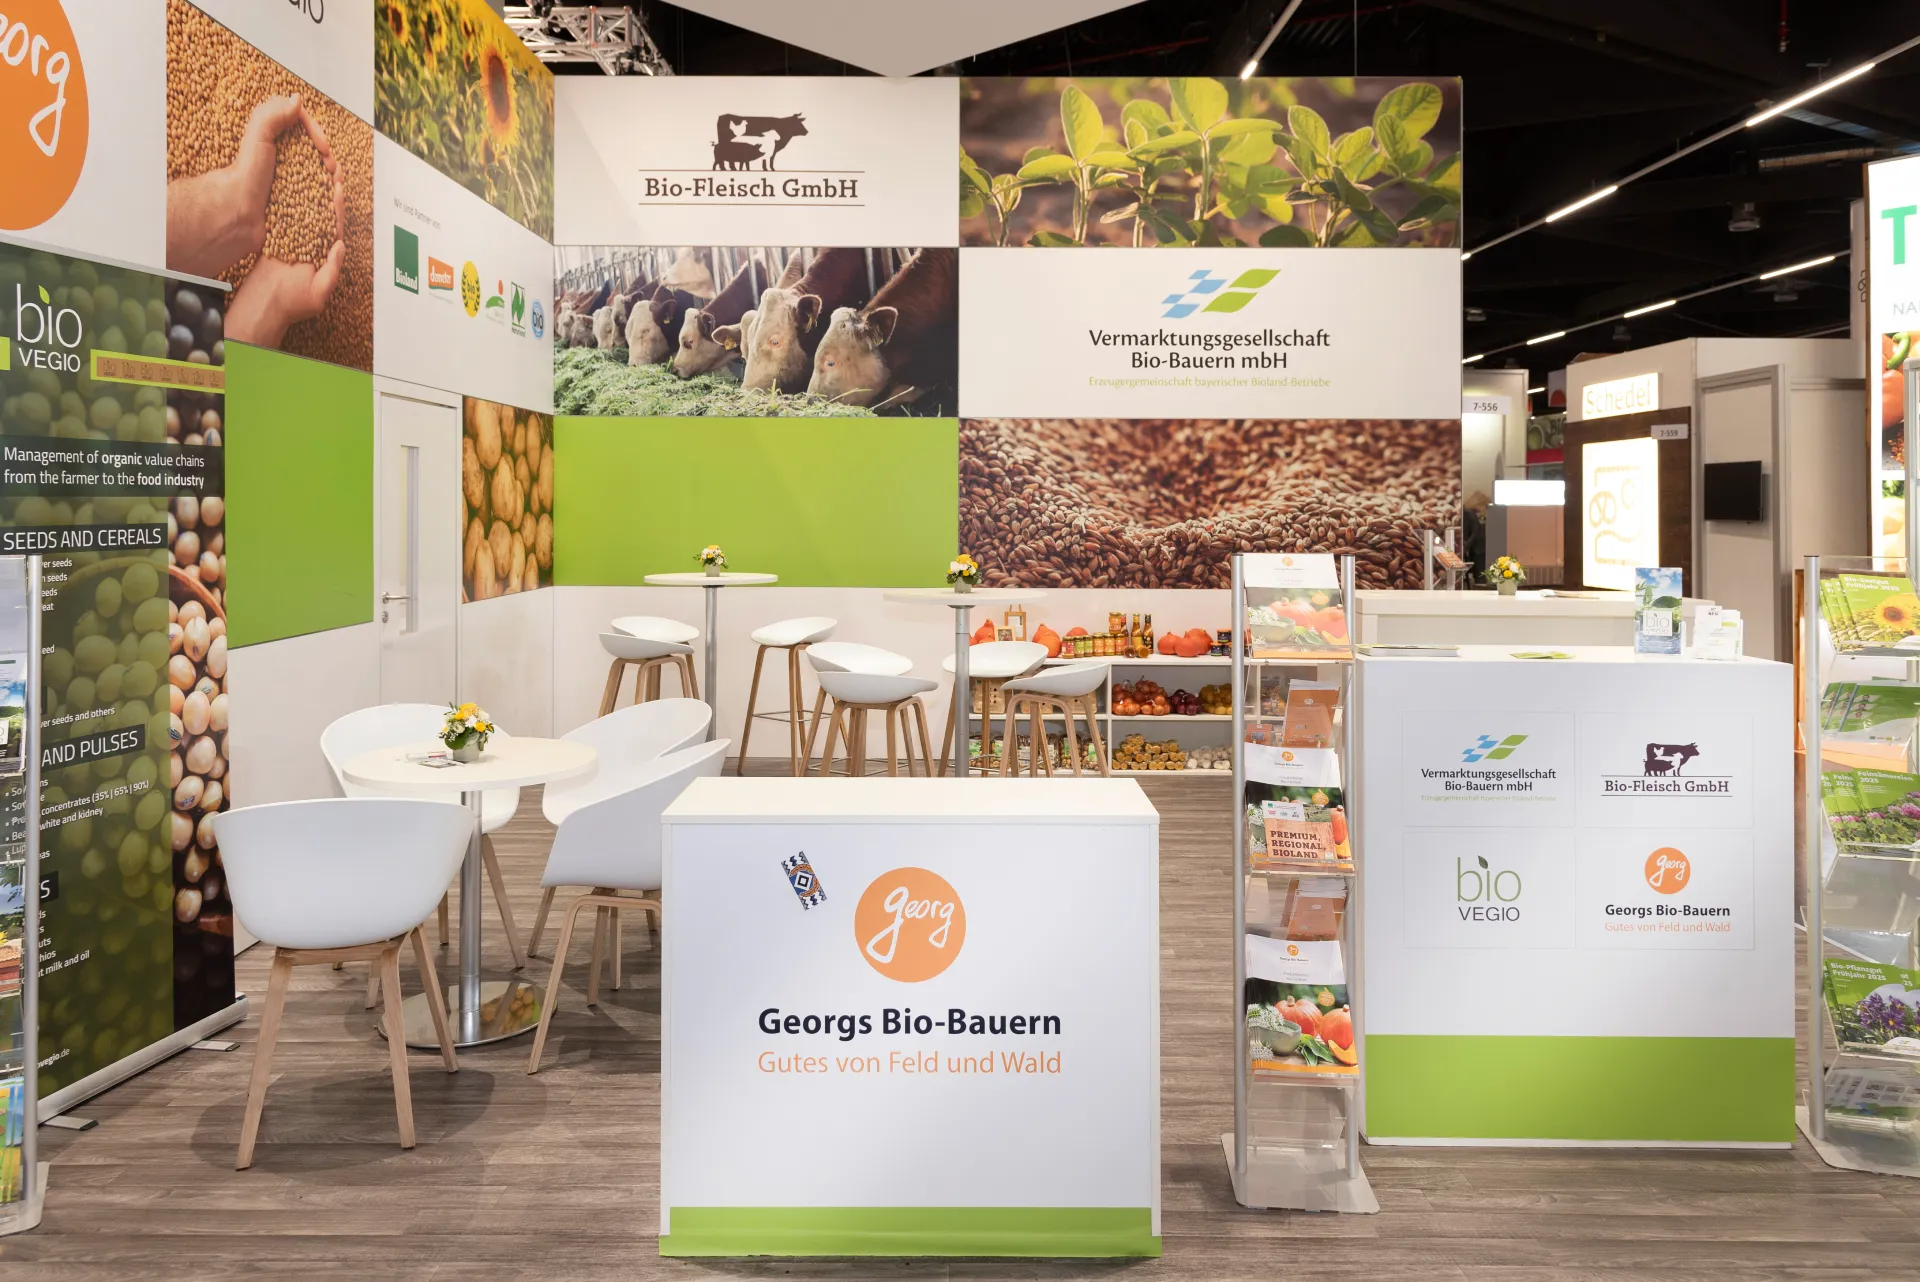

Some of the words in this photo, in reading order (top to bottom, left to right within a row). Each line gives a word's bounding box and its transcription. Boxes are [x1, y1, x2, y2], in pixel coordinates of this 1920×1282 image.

[645, 178, 776, 198] Bio-Fleisch
[782, 178, 859, 198] GmbH
[1881, 205, 1920, 265] T
[395, 267, 418, 290] Bioland
[17, 283, 82, 348] bio
[1089, 329, 1331, 351] Vermarktungsgesellschaft
[18, 348, 81, 373] VEGIO
[1132, 351, 1235, 369] Bio-Bauern
[1241, 351, 1287, 369] mbH
[1089, 377, 1192, 387] Erzeugergemeinschaft
[1195, 377, 1248, 387] bayerischer
[1251, 377, 1331, 387] Bioland-Betriebe
[1473, 402, 1498, 412] 7-556
[1660, 429, 1679, 437] 7-559
[4, 446, 84, 465] Management
[87, 450, 99, 464] of
[102, 453, 142, 467] organic
[145, 455, 173, 467] value
[175, 454, 205, 467] chains
[4, 469, 36, 484] from
[40, 470, 59, 484] the
[62, 471, 99, 485] farmer
[102, 473, 115, 485] to
[117, 472, 135, 486] the
[137, 473, 161, 486] food
[164, 474, 204, 489] industry
[3, 531, 57, 550] SEEDS
[61, 530, 93, 548] AND
[97, 528, 162, 546] CEREALS
[52, 558, 73, 568] seeds
[47, 573, 68, 582] seeds
[41, 588, 58, 597] eeds
[51, 714, 73, 726] seeds
[75, 711, 89, 722] and
[91, 707, 115, 718] others
[41, 743, 76, 767] AND
[80, 730, 138, 758] PULSES
[1421, 768, 1557, 781] Vermarktungsgesellschaft
[1445, 780, 1504, 791] Bio-Bauern
[1506, 780, 1533, 791] mbH
[1604, 780, 1682, 793] Bio-Fleisch
[1684, 780, 1729, 793] GmbH
[42, 796, 90, 816] concentrates
[40, 818, 61, 831] white
[62, 813, 77, 824] and
[78, 807, 103, 820] kidney
[1270, 830, 1321, 841] PREMIUM,
[1272, 840, 1326, 851] REGIONAL,
[1273, 849, 1318, 859] BIOLAND
[1457, 856, 1522, 902] bio
[1649, 854, 1686, 887] georg
[1458, 906, 1520, 922] VEGIO
[1605, 904, 1653, 919] Georgs
[1656, 904, 1731, 917] Bio-Bauern
[866, 886, 955, 963] georg
[1605, 922, 1634, 932] Gutes
[1635, 924, 1656, 932] von
[1659, 921, 1680, 932] Feld
[1682, 921, 1703, 932] und
[1704, 921, 1731, 932] Wald
[45, 960, 63, 975] milk
[64, 953, 79, 967] and
[80, 950, 90, 962] oil
[1830, 963, 1883, 974] Bio-Pflanzgut
[1833, 970, 1865, 979] Frühjahr
[1868, 973, 1886, 981] 2025
[758, 1008, 873, 1042] Georgs
[882, 1007, 1061, 1035] Bio-Bauern
[758, 1051, 828, 1073] Gutes
[835, 1058, 880, 1073] von
[889, 1050, 938, 1073] Feld
[947, 1050, 994, 1073] und
[1001, 1050, 1061, 1073] Wald
